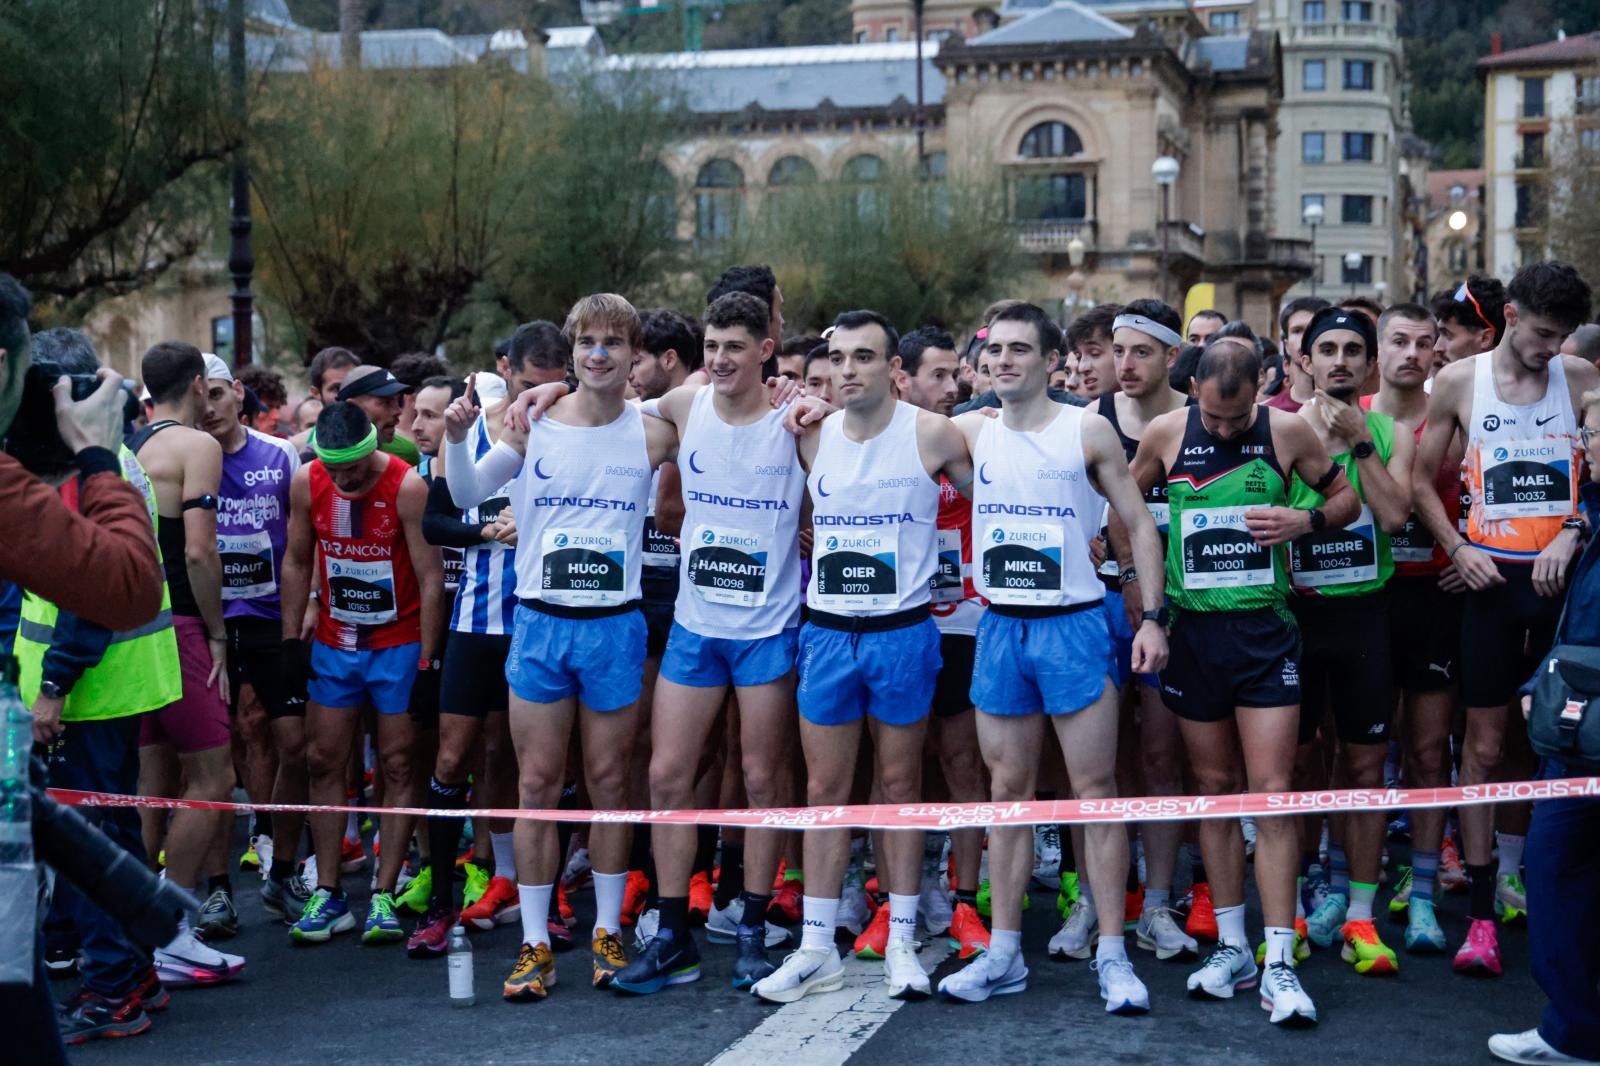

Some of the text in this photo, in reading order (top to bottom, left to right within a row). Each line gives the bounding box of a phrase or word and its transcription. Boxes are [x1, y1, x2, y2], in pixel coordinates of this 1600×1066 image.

[1513, 447, 1555, 458] ZURICH
[244, 465, 284, 487] gahp
[1037, 469, 1079, 482] MHN
[1512, 474, 1554, 487] MAEL
[878, 477, 920, 489] MHN
[687, 490, 790, 511] DONOSTIA
[1513, 491, 1547, 501] 10032
[534, 497, 636, 512] DONOSTIA
[978, 503, 1077, 518] DONOSTIA
[814, 512, 915, 526] DONOSTIA
[1213, 515, 1245, 525] ZURIC
[573, 536, 612, 546] ZURICH
[719, 535, 758, 546] ZURICH
[842, 538, 881, 548] ZURICH
[1008, 532, 1047, 542] ZURICH
[650, 543, 675, 553] 10052
[1201, 542, 1262, 556] ANDONI
[1312, 540, 1363, 555] PIERRE
[568, 562, 609, 575] HUGO
[698, 560, 766, 576] HARKAITZ
[1004, 560, 1046, 573] MIKEL
[1213, 559, 1245, 570] 10001
[1319, 557, 1352, 569] 10042
[345, 566, 378, 576] ZURICH
[842, 567, 876, 578] OIER
[570, 579, 600, 589] 10140
[712, 577, 745, 589] 10098
[842, 583, 870, 593] 10170
[1004, 577, 1036, 588] 10004
[342, 588, 381, 600] JORGE
[347, 601, 371, 612] 10163
[1462, 781, 1570, 800] SPORTS
[1266, 791, 1370, 808] SPORTS
[898, 805, 993, 816] SPORTS
[1079, 799, 1180, 814] SPORTS
[762, 815, 816, 825] RPM
